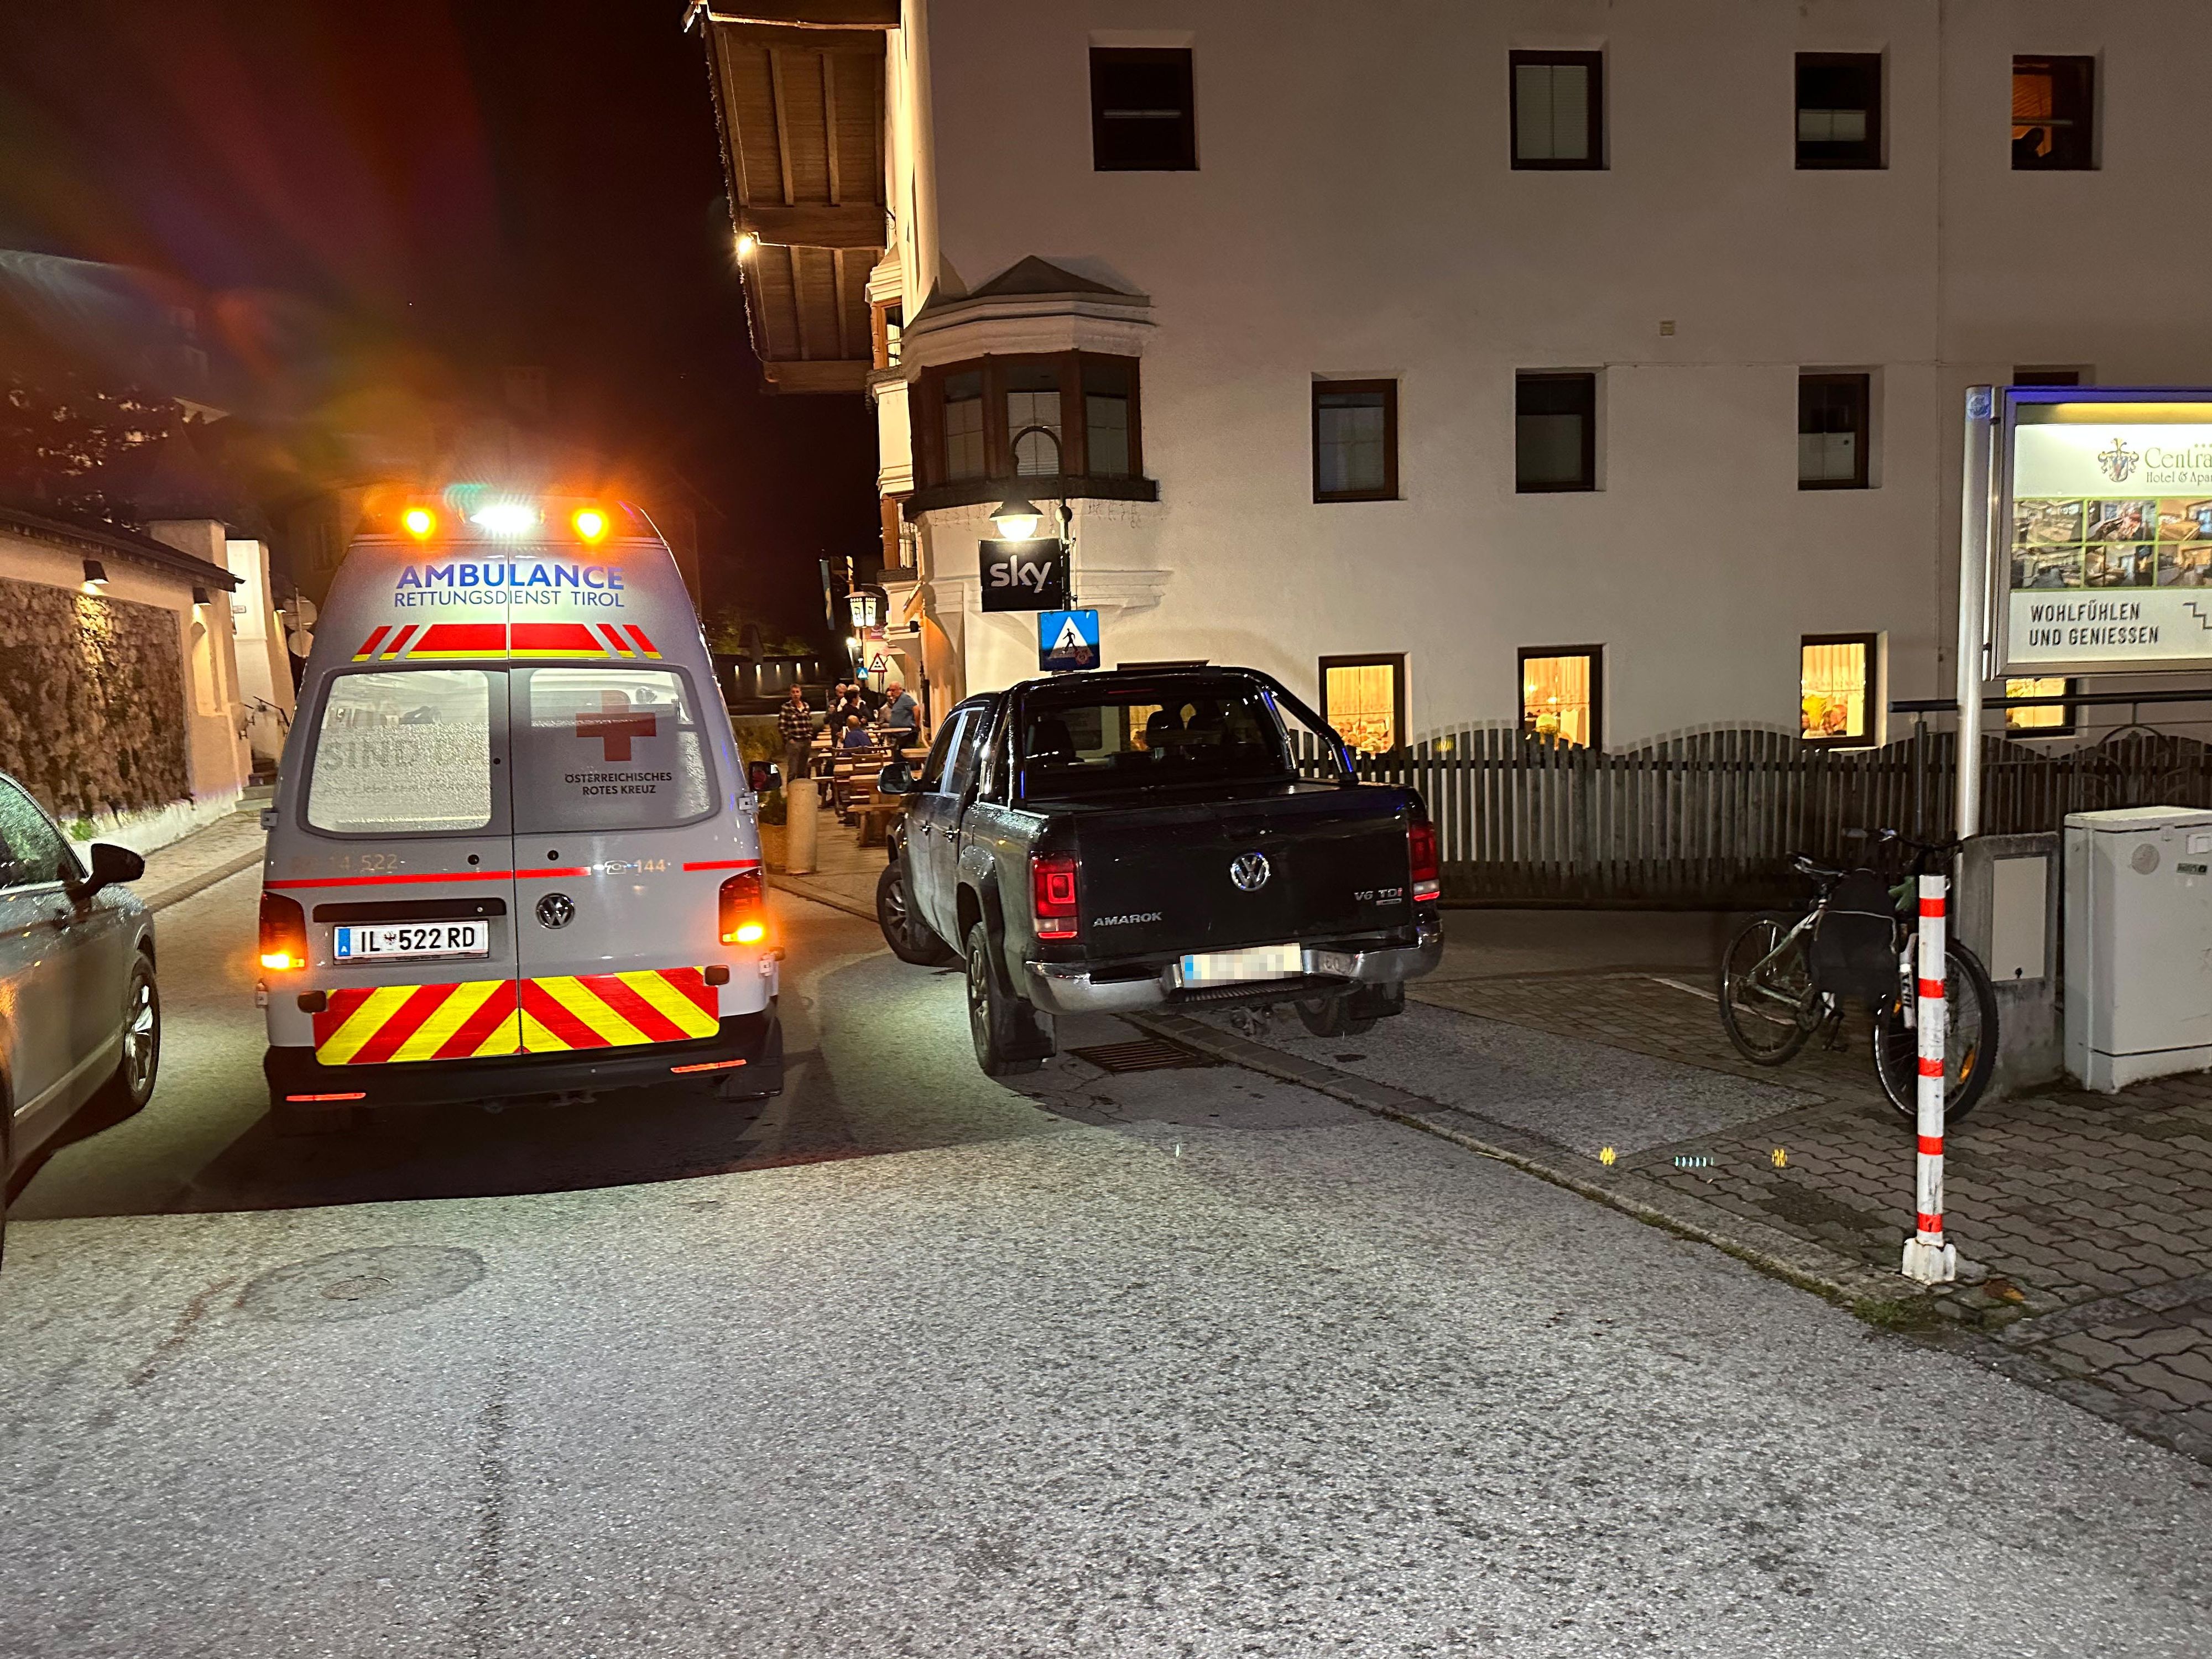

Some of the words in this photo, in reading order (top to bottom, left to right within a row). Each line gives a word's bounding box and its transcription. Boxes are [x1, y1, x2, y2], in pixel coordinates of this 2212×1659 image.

[2147, 471, 2174, 483] Hotel
[2178, 471, 2188, 483] &
[395, 564, 625, 590] AMBULANCE
[989, 555, 1052, 593] sky
[394, 590, 561, 607] RETTUNGSDIENST
[571, 591, 625, 608] TIROL
[2030, 599, 2141, 623] WOHLFÜHLEN
[2029, 628, 2062, 646] UND
[2068, 625, 2159, 646] GENIESSEN
[565, 772, 672, 784] ÖSTERREICHISCHES
[582, 785, 618, 795] ROTES
[620, 784, 656, 794] KREUZ
[361, 853, 398, 871] 522
[636, 858, 666, 873] 144
[1353, 890, 1374, 901] V6
[1092, 911, 1163, 927] AMAROK
[361, 931, 381, 953] IL
[399, 928, 441, 951] 522
[447, 926, 475, 948] RD
